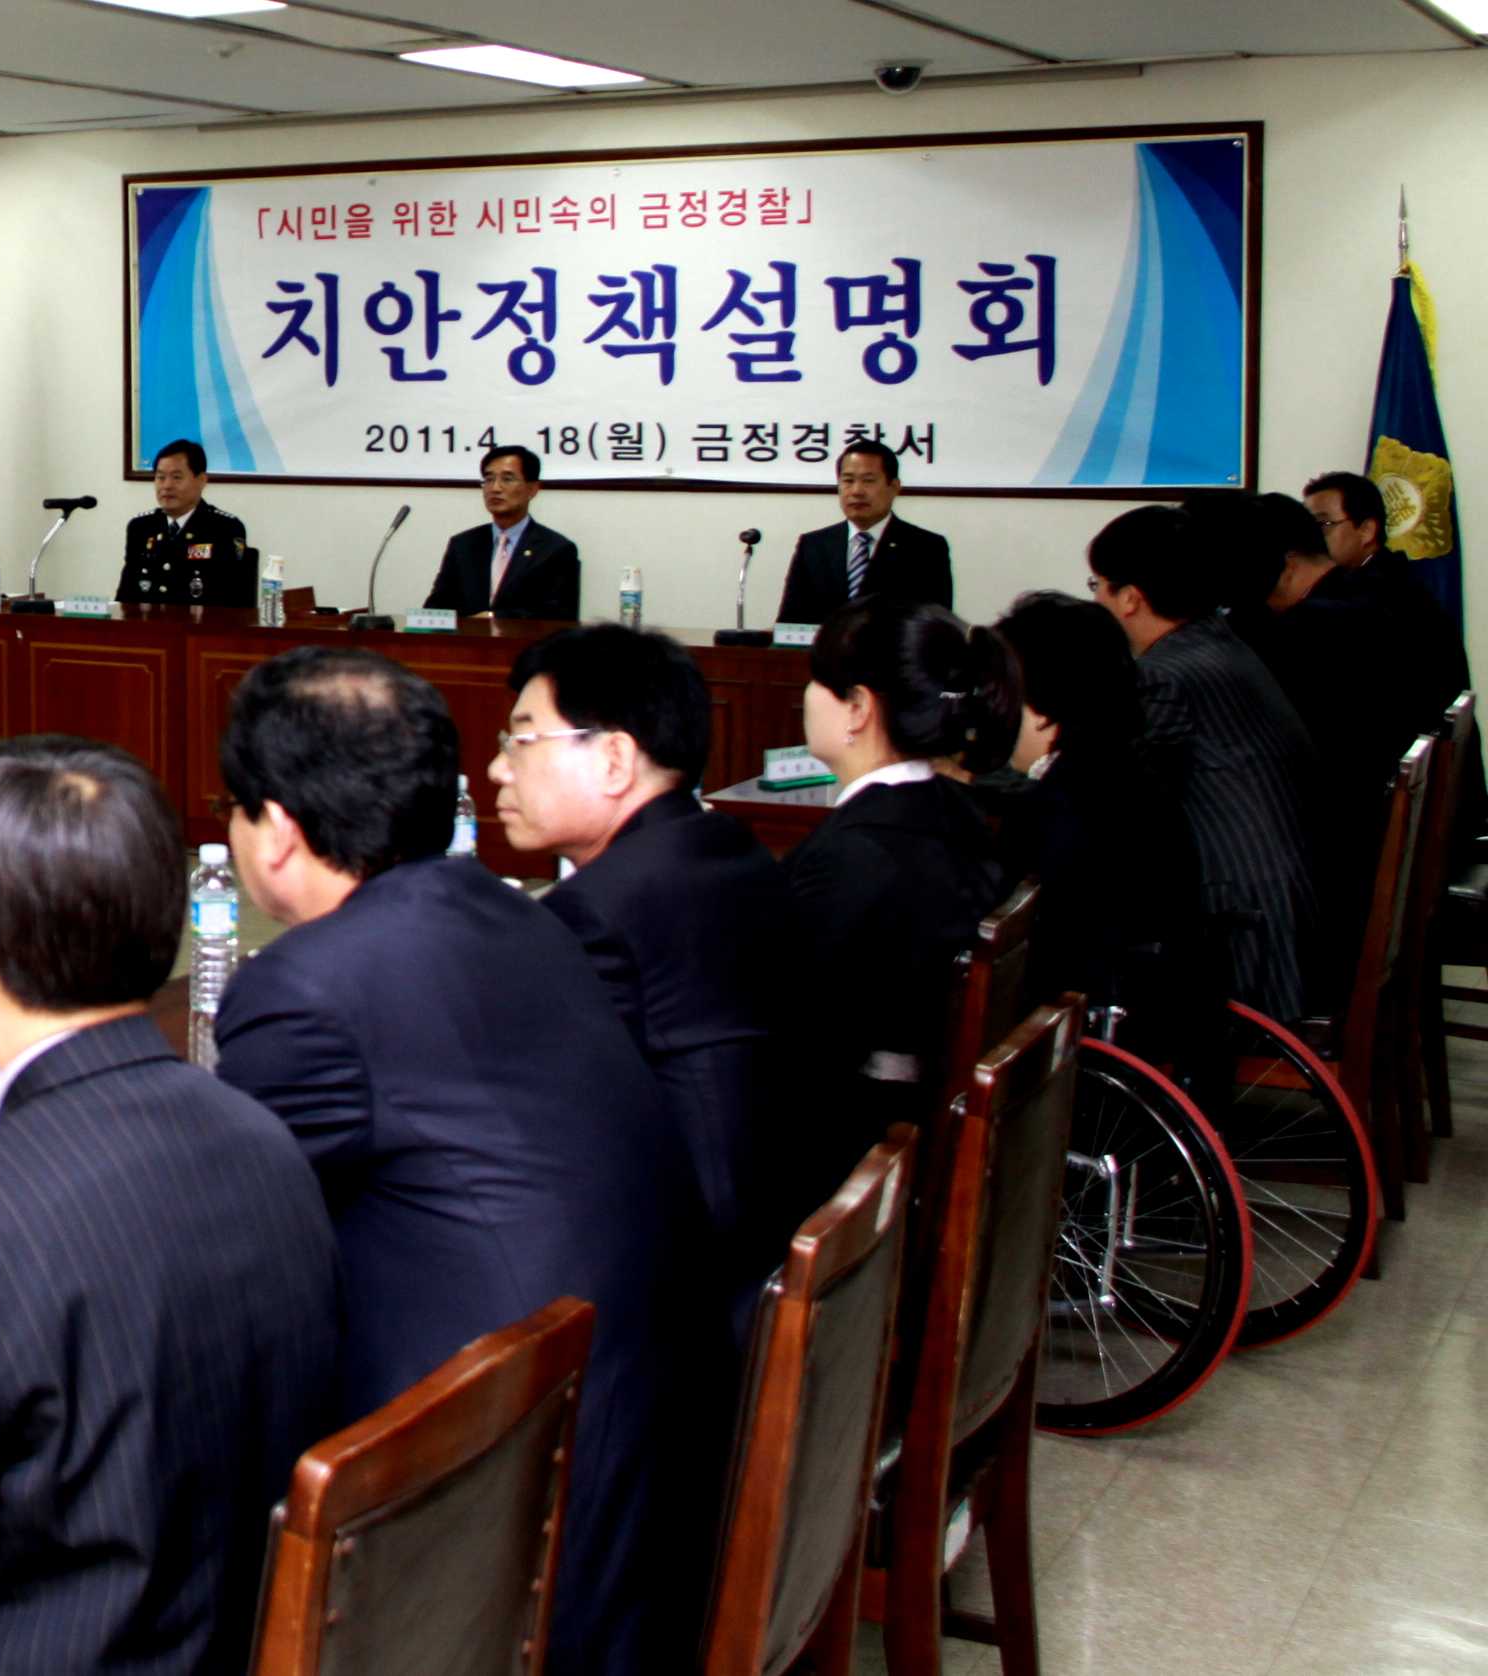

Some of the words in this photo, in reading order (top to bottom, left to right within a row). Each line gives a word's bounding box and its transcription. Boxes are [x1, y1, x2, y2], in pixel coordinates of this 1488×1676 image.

[392, 199, 457, 237] 위한
[476, 193, 616, 234] 시민속의
[261, 254, 1058, 388] 치안정책설명회
[537, 421, 666, 461] 18(월)
